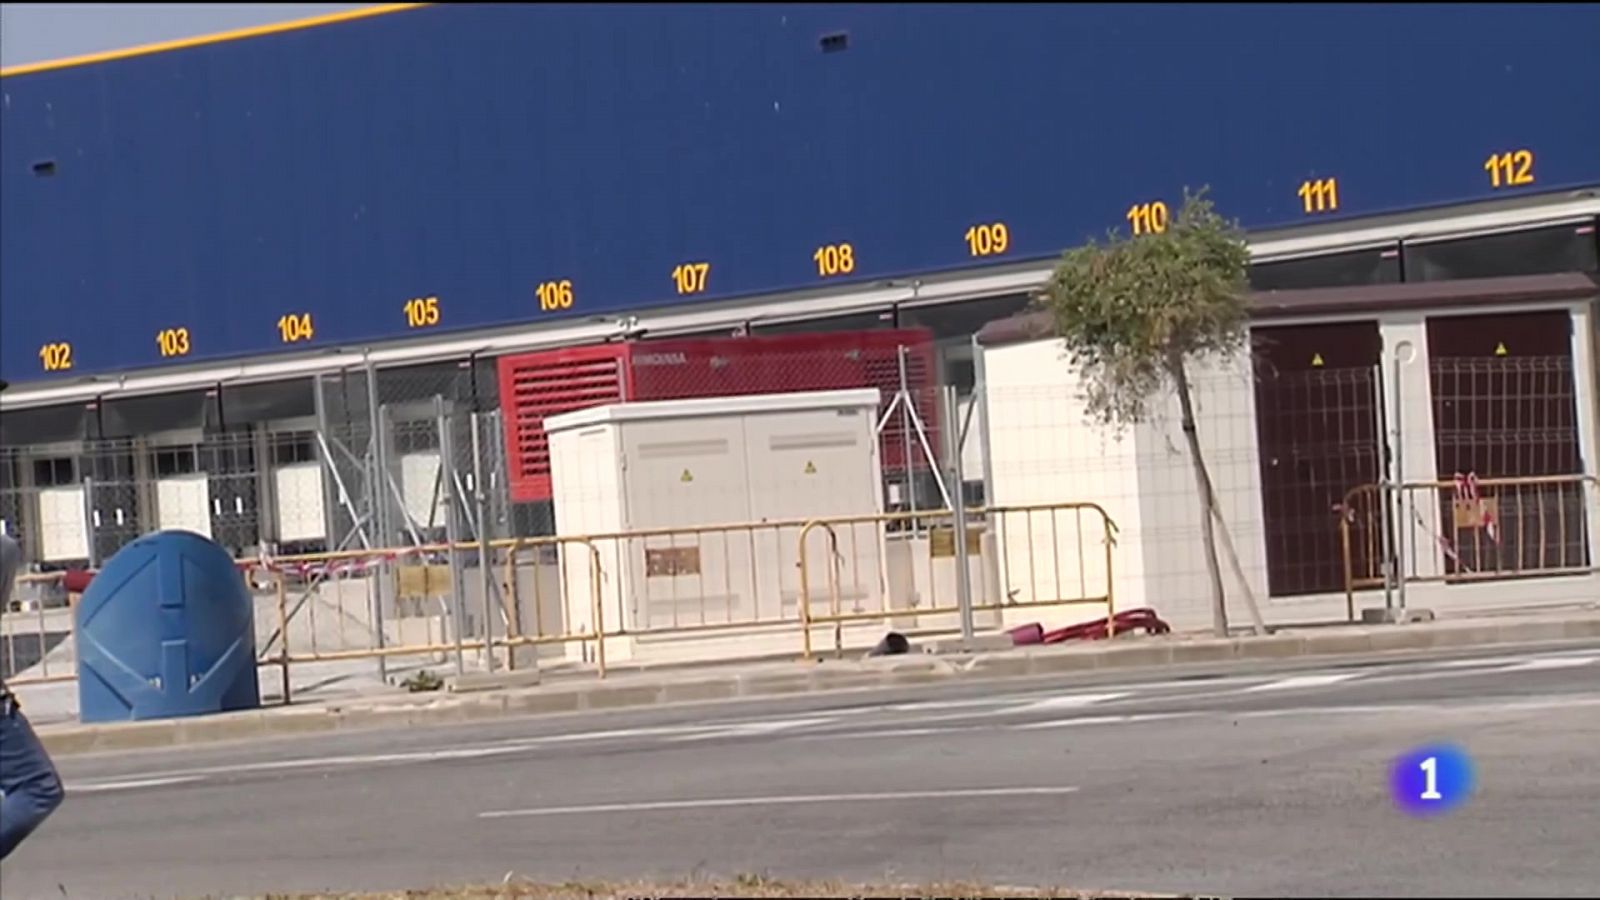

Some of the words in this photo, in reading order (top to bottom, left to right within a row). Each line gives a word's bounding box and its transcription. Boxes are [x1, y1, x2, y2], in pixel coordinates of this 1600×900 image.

[1486, 149, 1534, 186] 112
[1298, 178, 1338, 211] 111
[1127, 202, 1169, 236] 110
[965, 224, 1008, 257] 109
[814, 243, 854, 276] 108
[672, 262, 709, 293] 107
[536, 281, 573, 311] 106
[278, 314, 313, 342] 104
[404, 298, 439, 327] 105
[39, 342, 72, 370] 102
[157, 328, 190, 356] 103
